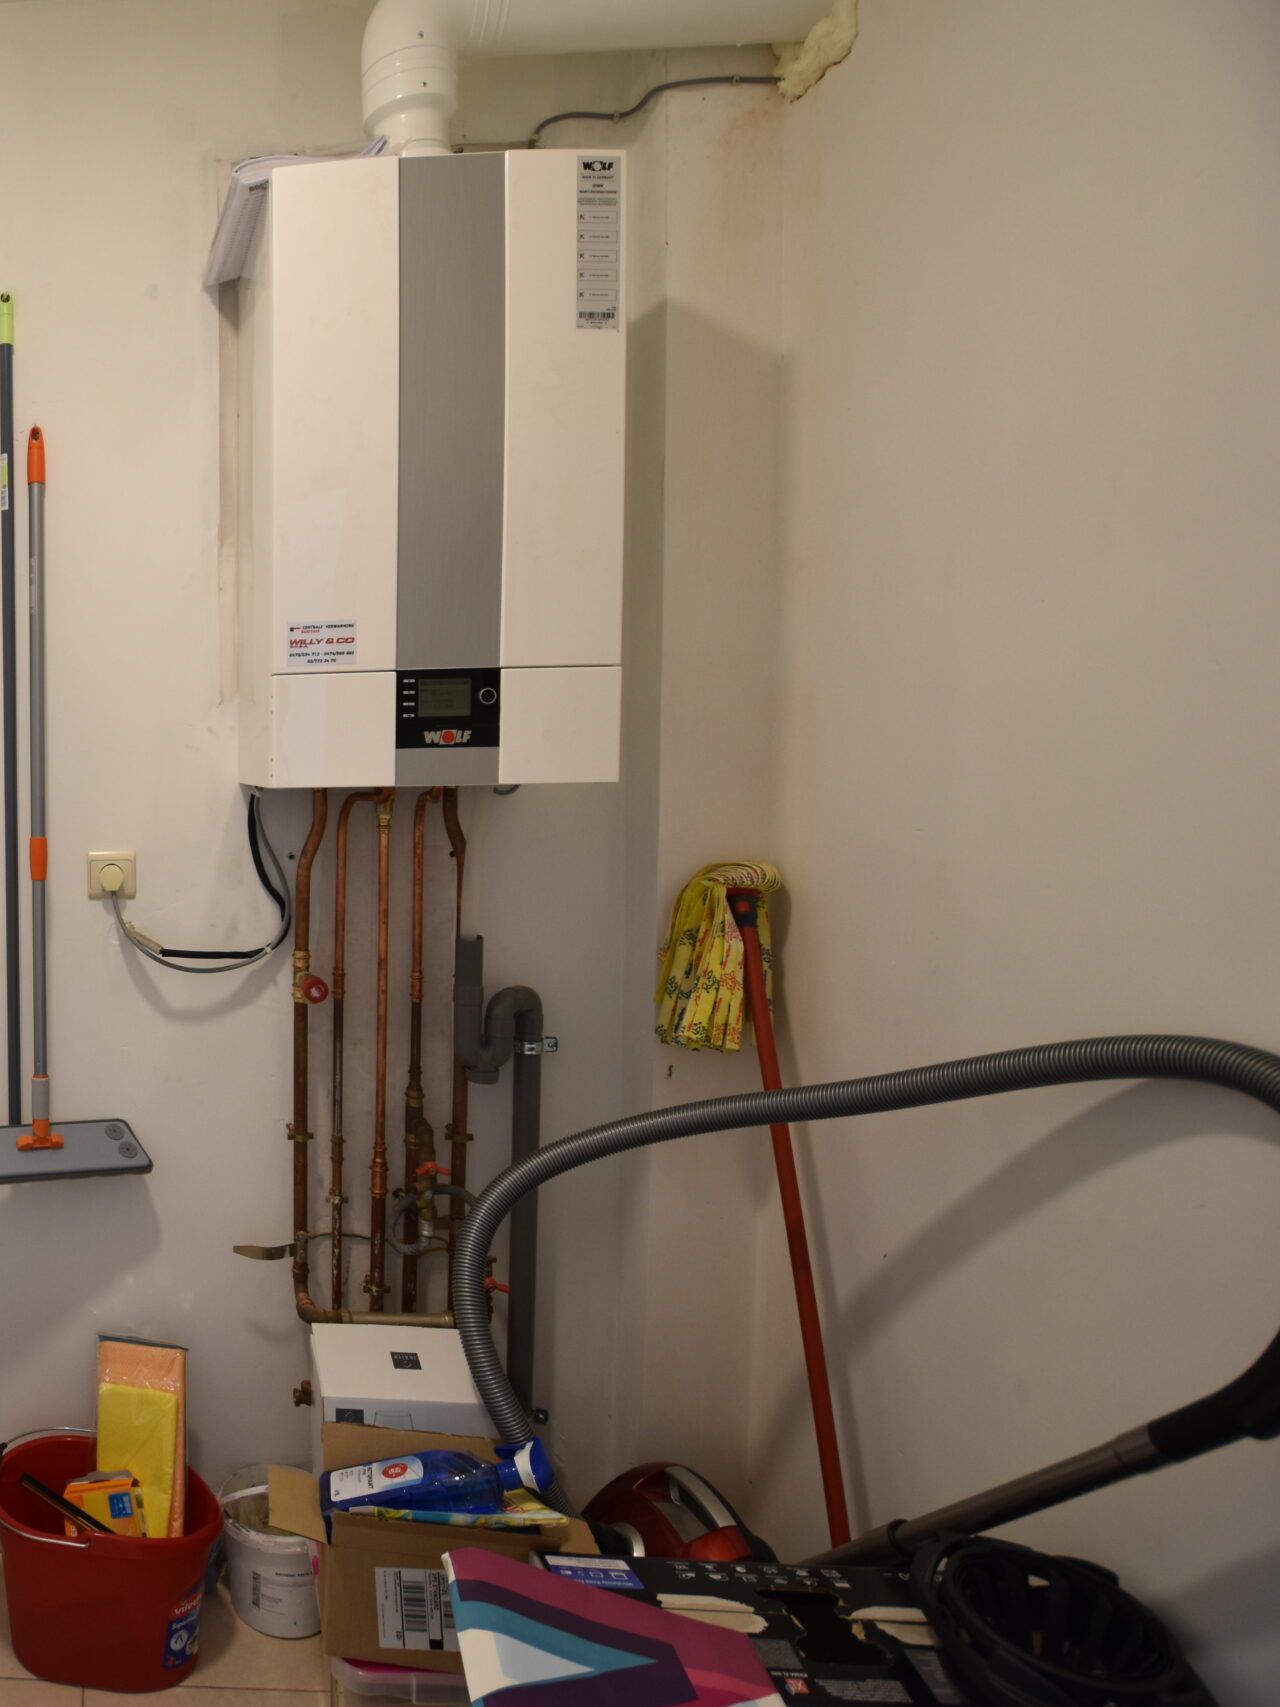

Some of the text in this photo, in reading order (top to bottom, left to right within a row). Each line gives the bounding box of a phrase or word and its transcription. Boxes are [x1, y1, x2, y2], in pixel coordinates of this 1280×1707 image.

[582, 160, 614, 171] WOLF
[289, 636, 355, 647] WILLY & CO
[423, 729, 472, 745] WOLF
